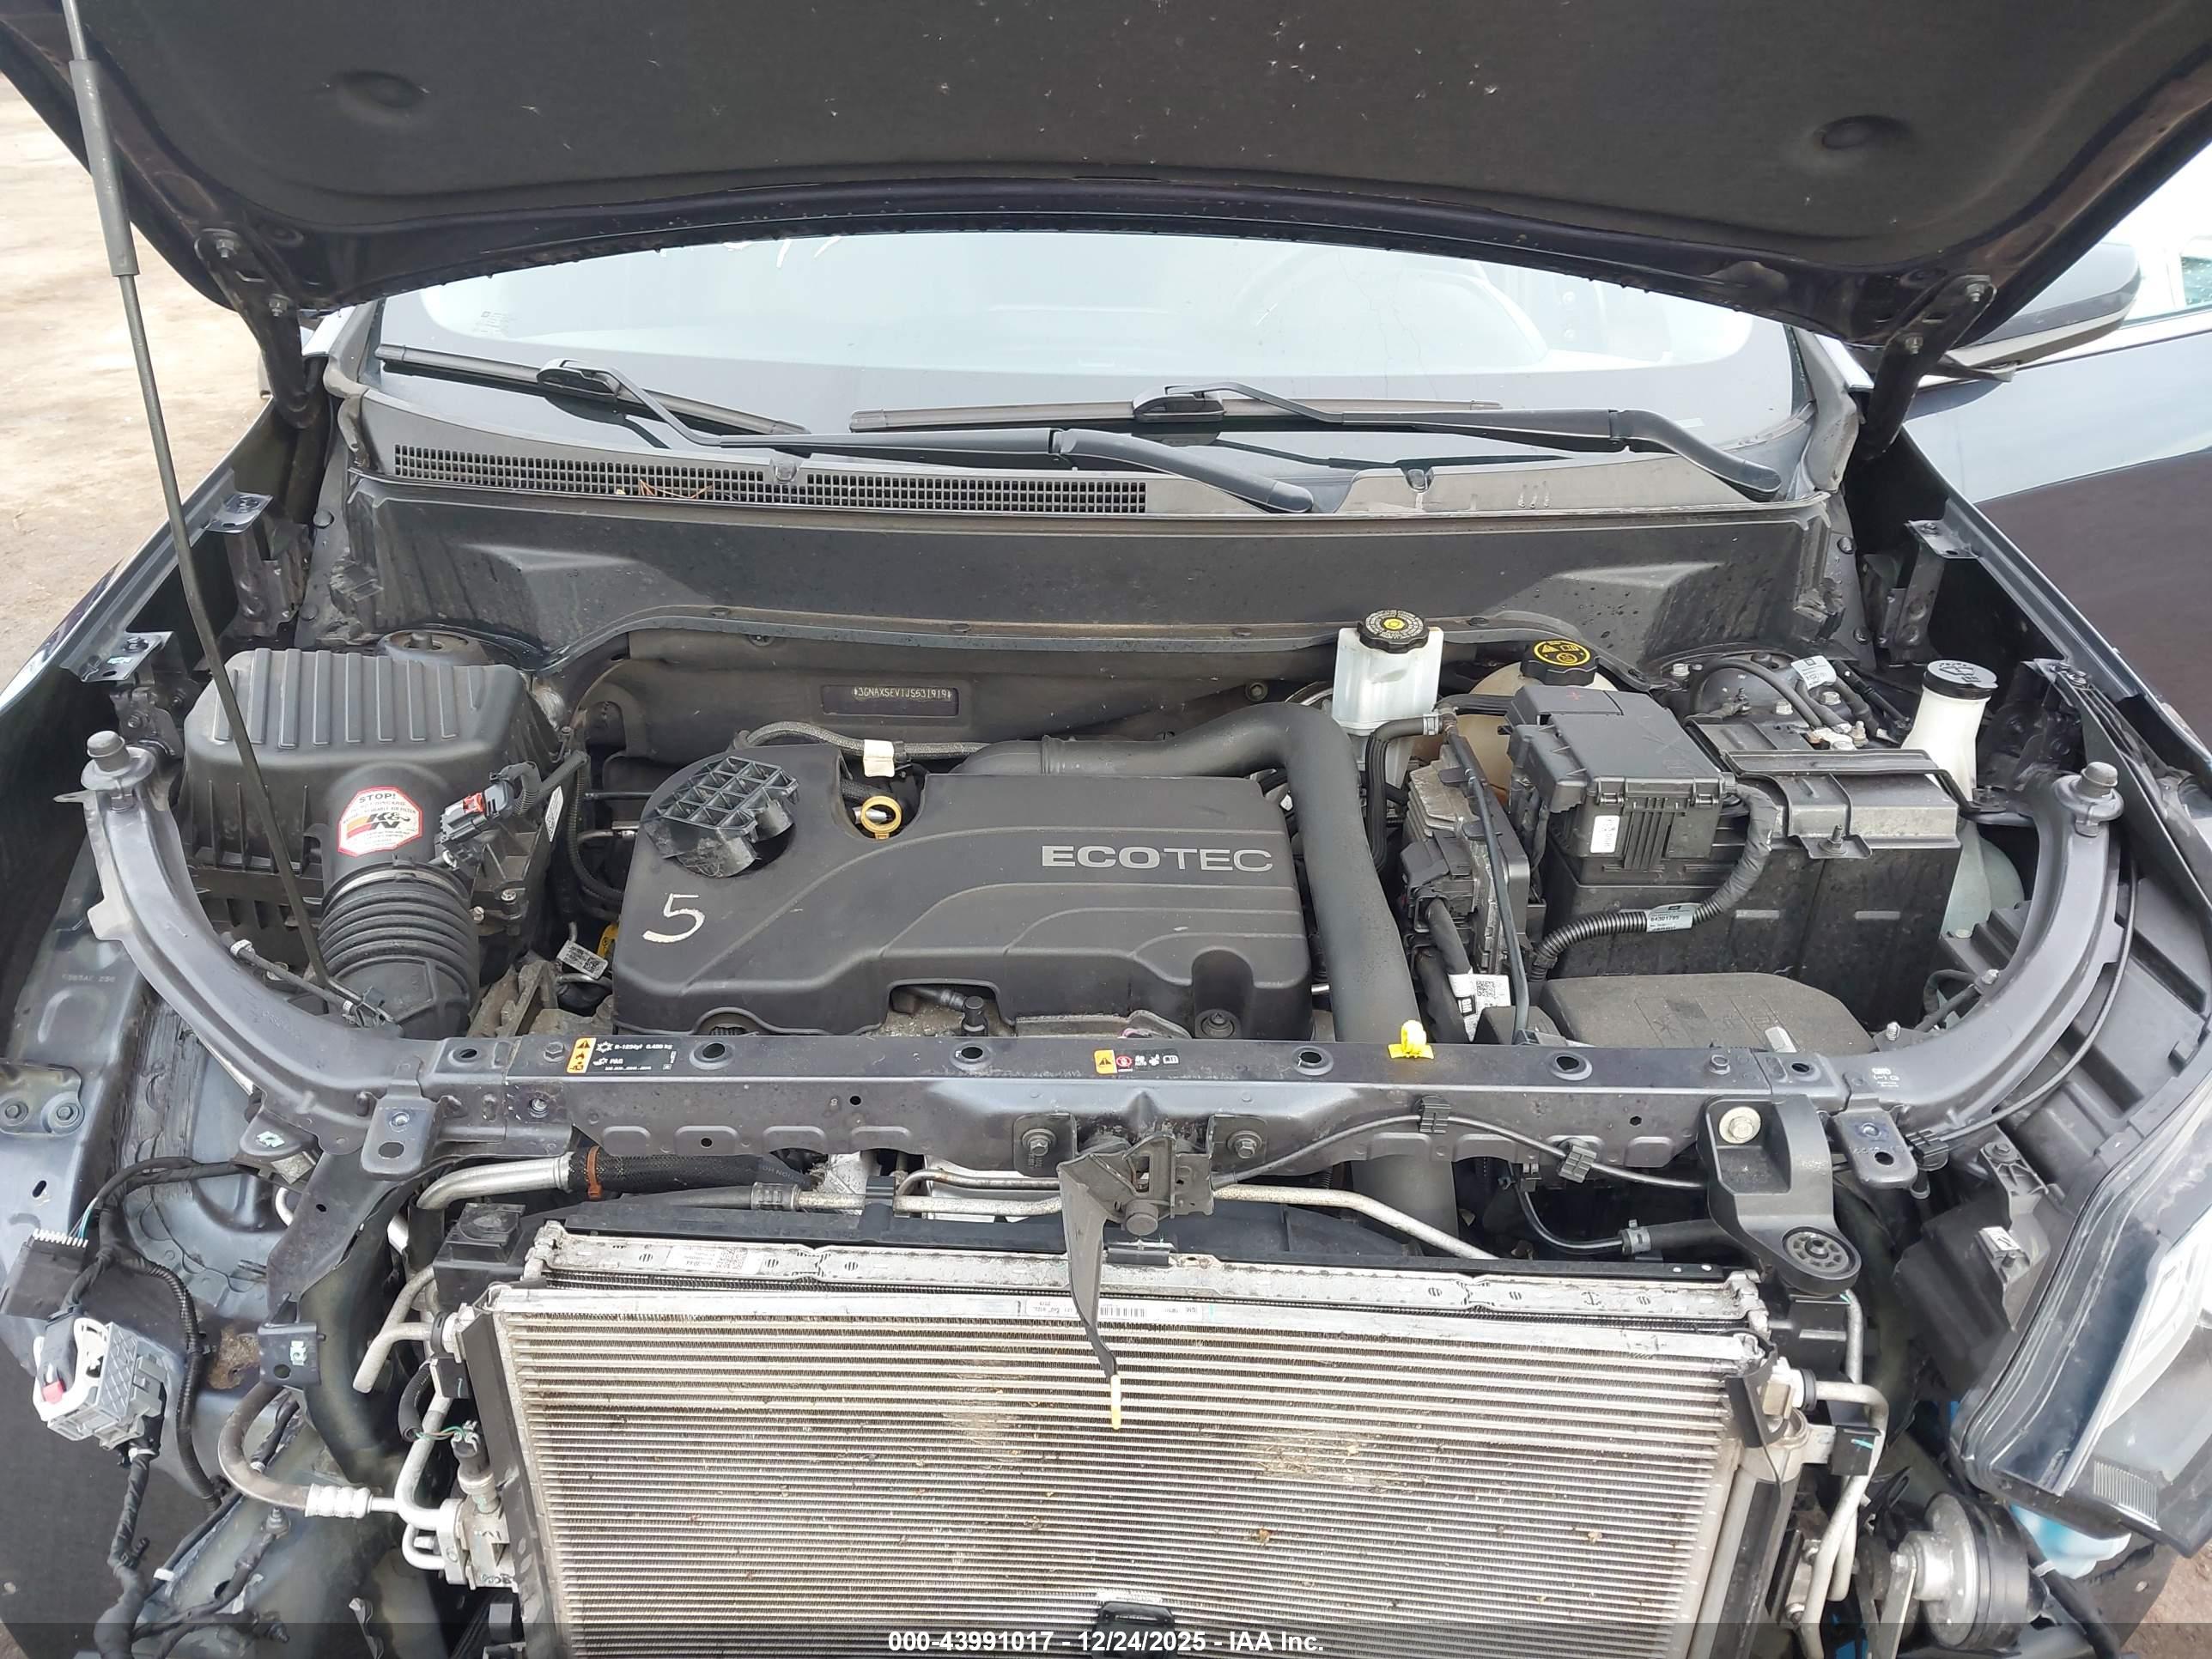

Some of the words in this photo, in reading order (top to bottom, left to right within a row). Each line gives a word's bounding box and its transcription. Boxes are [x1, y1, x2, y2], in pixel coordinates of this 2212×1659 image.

[359, 793, 396, 803] STOP!
[1042, 845, 1273, 872] ECOTEC
[642, 893, 705, 943] 5
